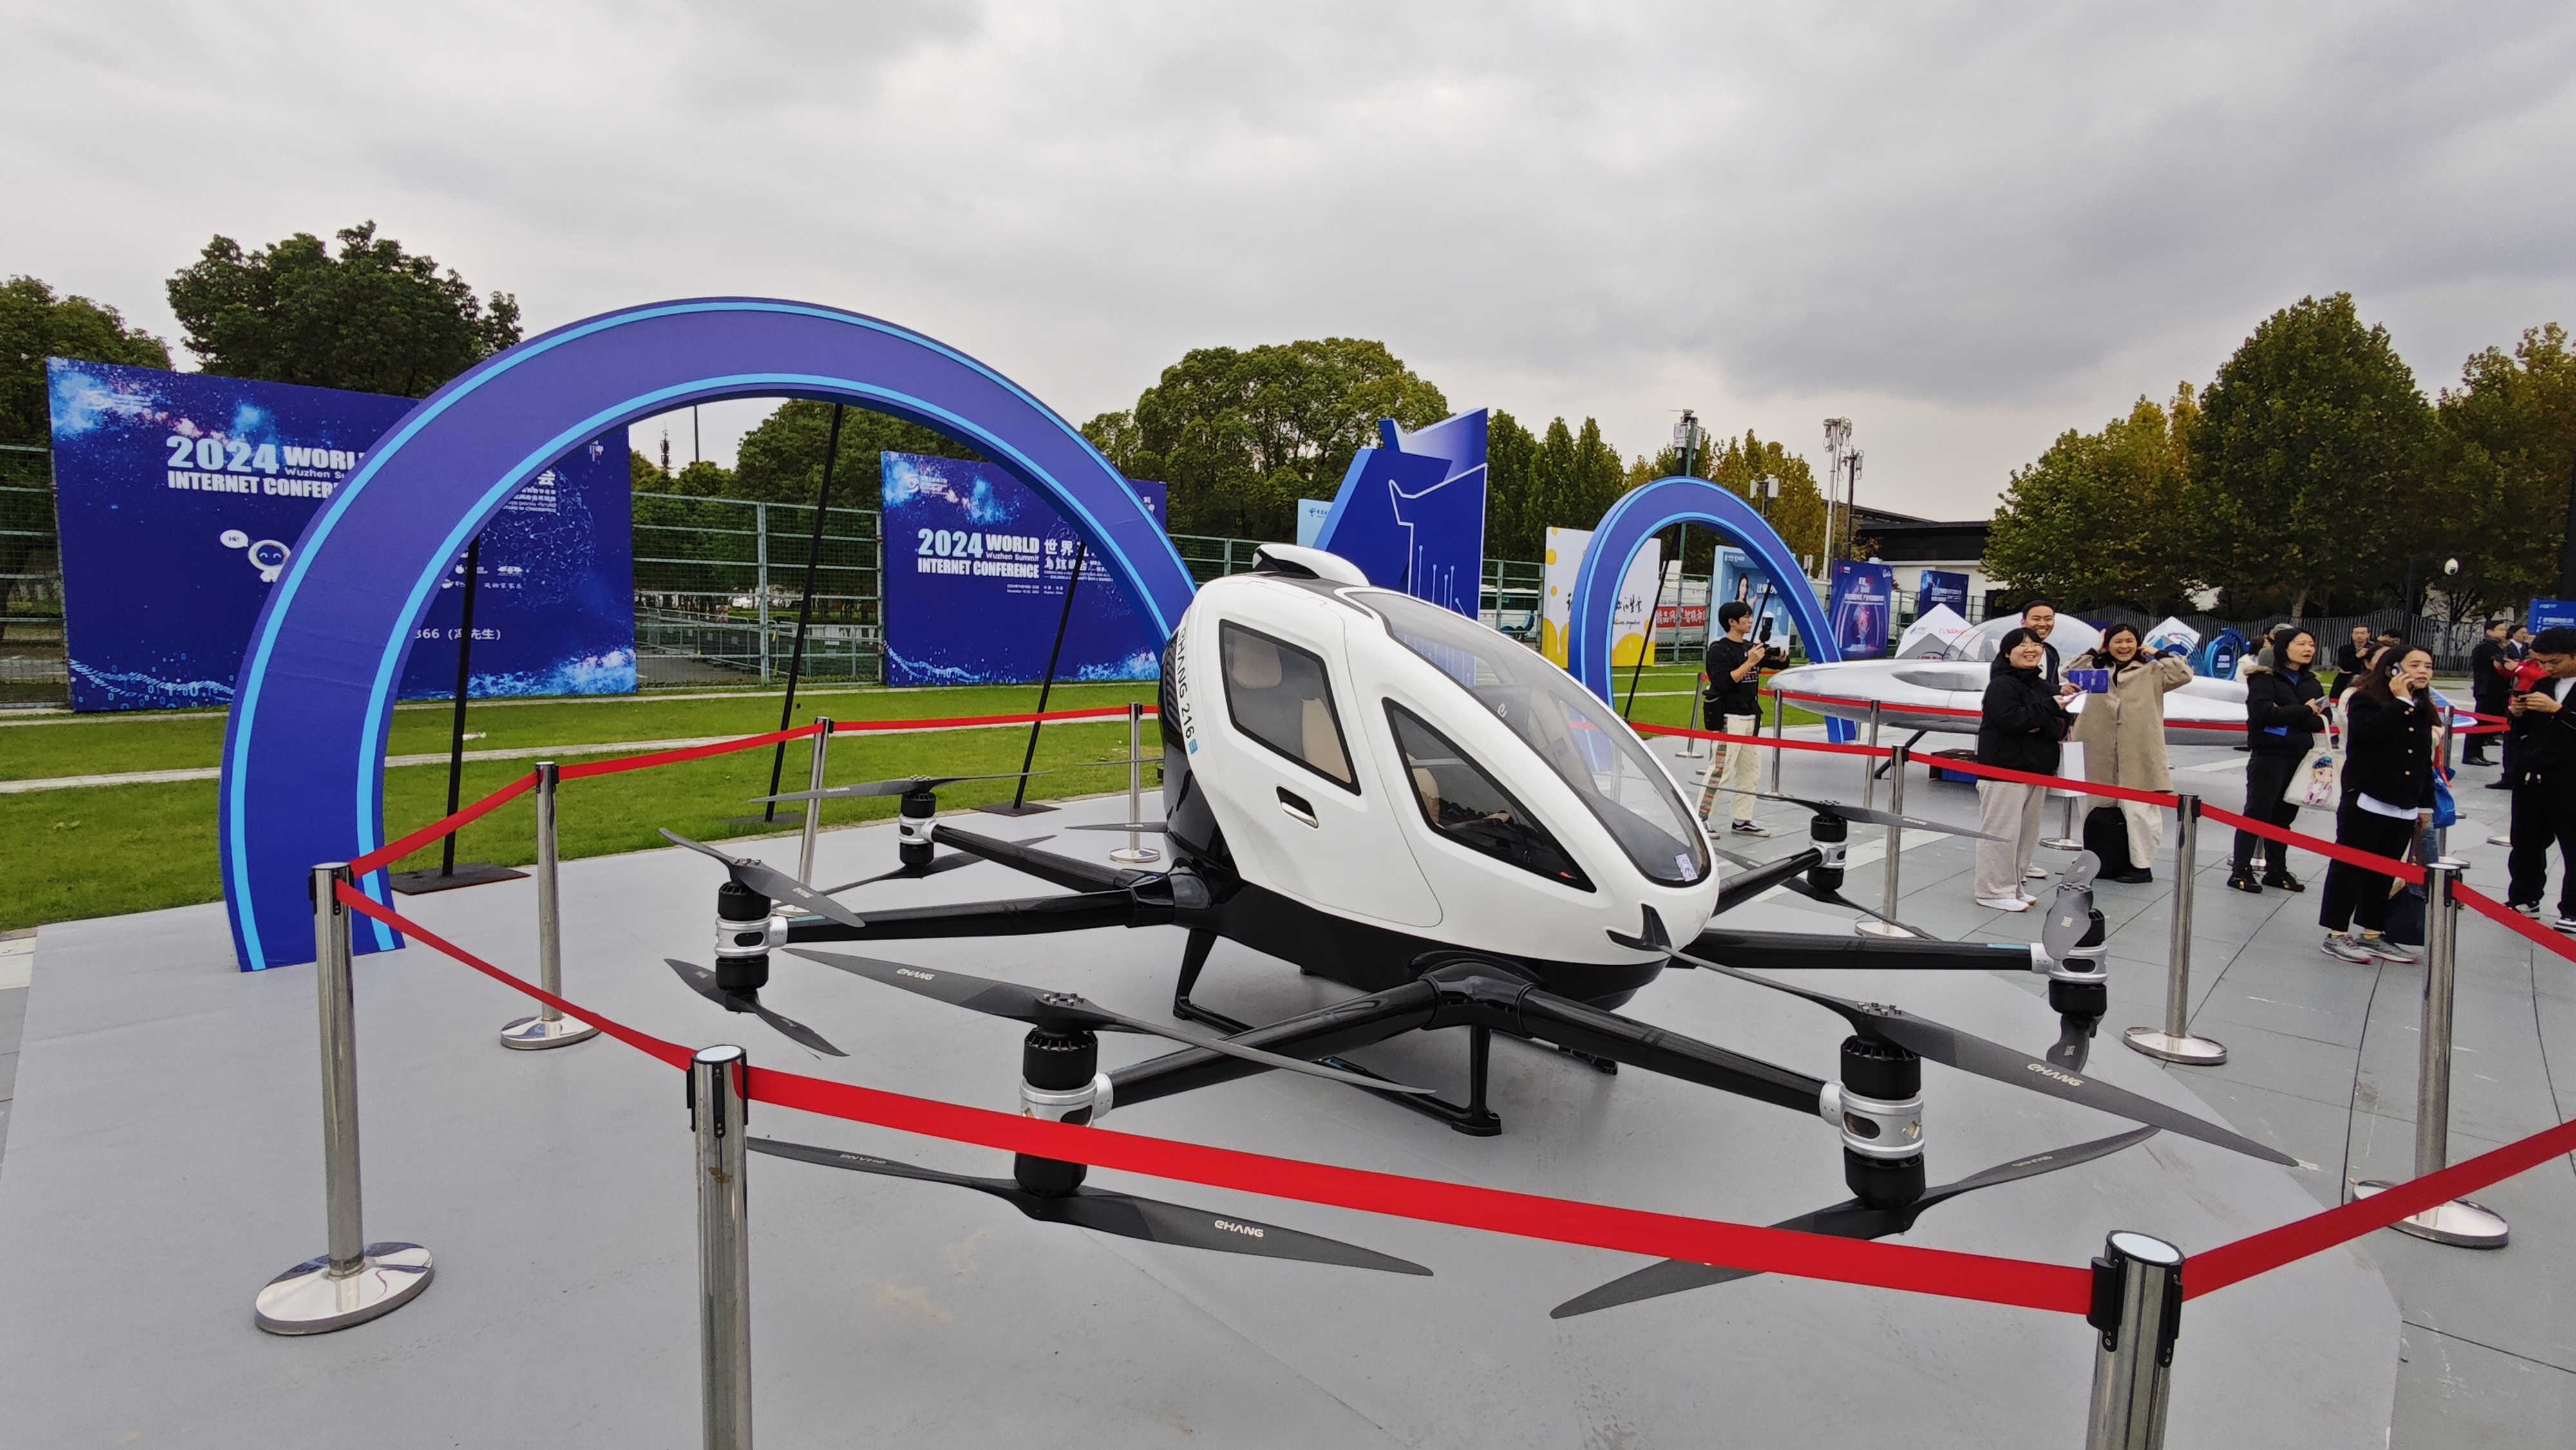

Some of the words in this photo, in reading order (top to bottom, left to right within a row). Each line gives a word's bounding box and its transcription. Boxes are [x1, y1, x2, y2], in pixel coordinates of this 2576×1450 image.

[166, 435, 279, 475] 2024
[283, 446, 365, 470] WORL
[167, 471, 260, 494] INTERNET
[263, 478, 339, 498] CONFER
[284, 467, 330, 479] Wuzhen
[918, 529, 983, 558] 2024
[985, 534, 1039, 554] WORLD
[986, 552, 1013, 560] Wuzhen
[918, 558, 971, 575] INTERNET
[973, 561, 1039, 578] CONFERENCE
[1181, 702, 1195, 739] 216
